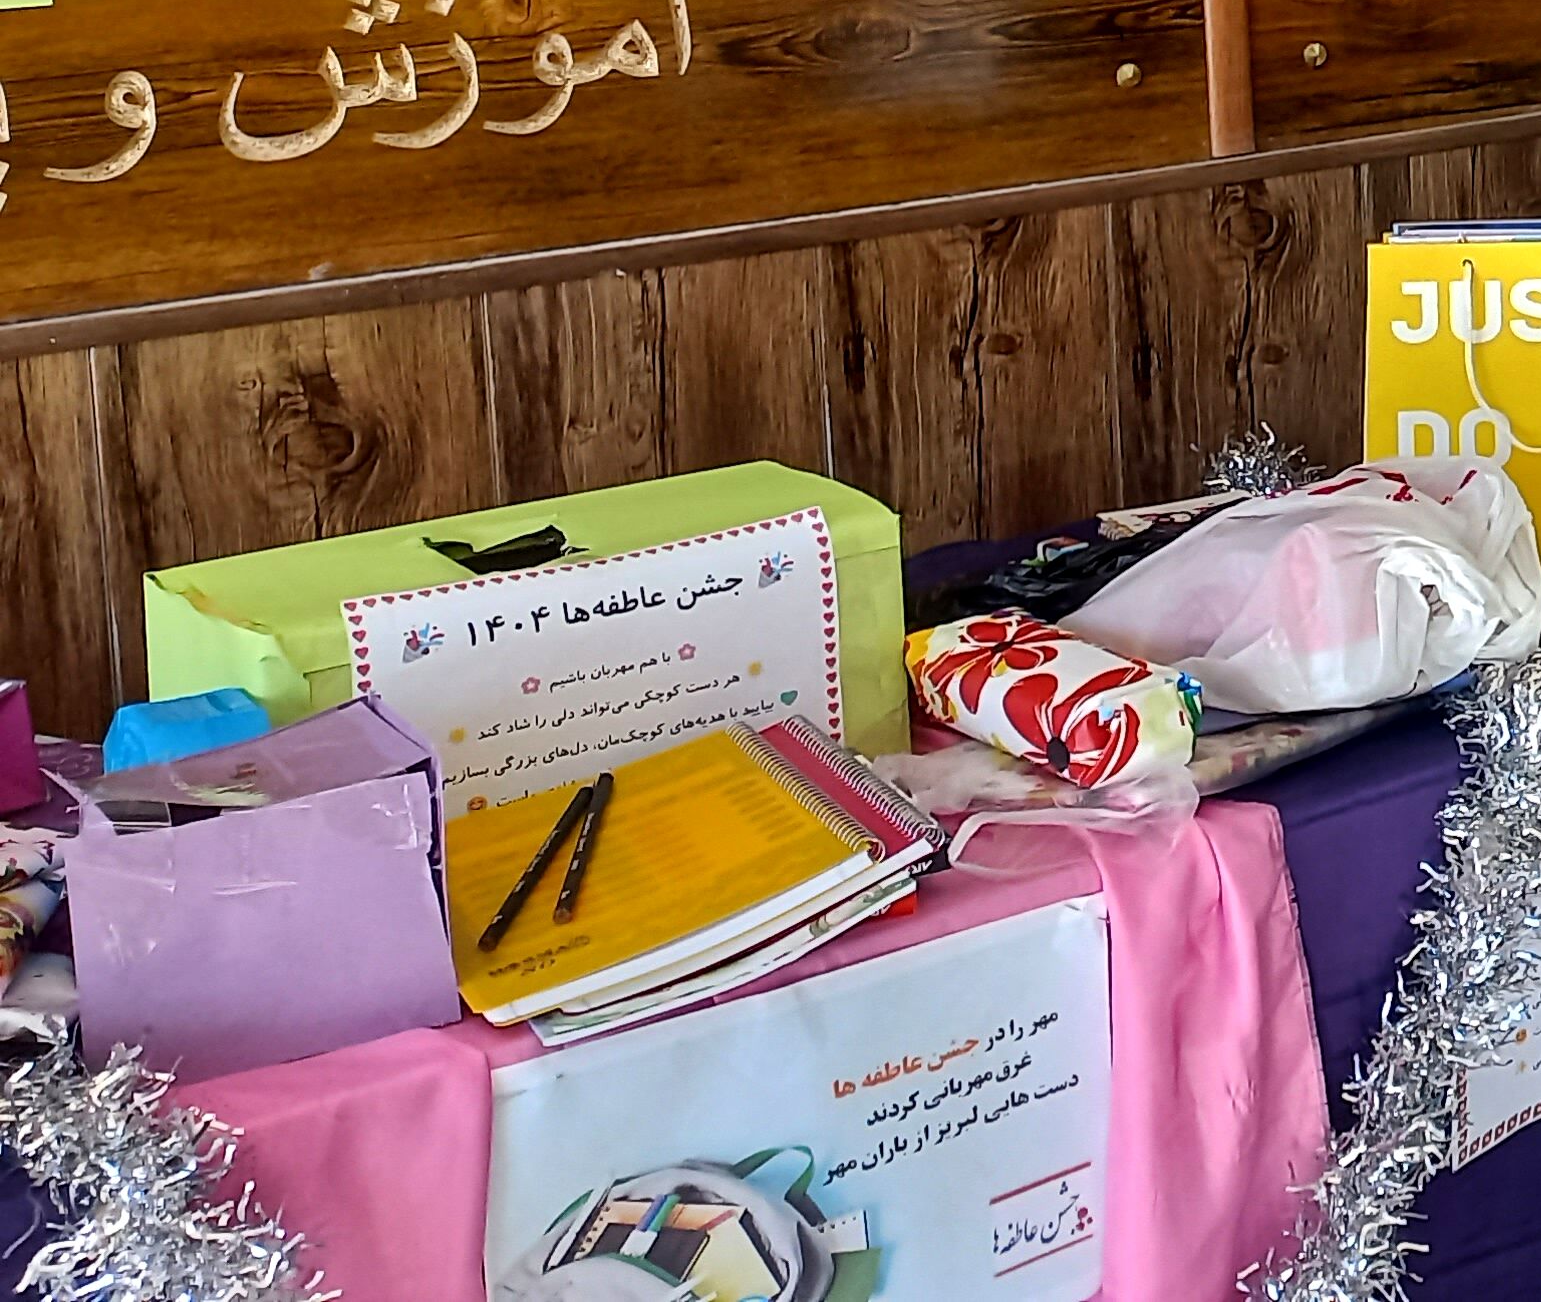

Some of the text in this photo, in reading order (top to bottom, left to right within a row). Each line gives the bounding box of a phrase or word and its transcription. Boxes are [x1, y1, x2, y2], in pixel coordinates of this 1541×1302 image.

[43, 70, 156, 183] و
[676, 573, 743, 610] جشن
[466, 605, 550, 647] ۱۴۰۴
[550, 652, 671, 692] با هم مهربان باشیم
[723, 673, 740, 689] هر
[634, 684, 681, 708] کوچکی
[685, 678, 719, 695] دست
[551, 708, 575, 727] دلی
[728, 707, 738, 721] با
[741, 698, 774, 717] بیایید
[477, 723, 501, 741] کند
[506, 717, 531, 733] شاد
[535, 714, 547, 729] را
[441, 763, 490, 790] بسازیم
[494, 753, 538, 777] بزرگی
[833, 1011, 1058, 1099] مهر را در جشن عاطفه ها
[867, 1050, 1032, 1126] غرق مهربانی کردند
[823, 1073, 1079, 1187] دست هایی لبریز از باران مهر
[1041, 1181, 1080, 1244] جشن
